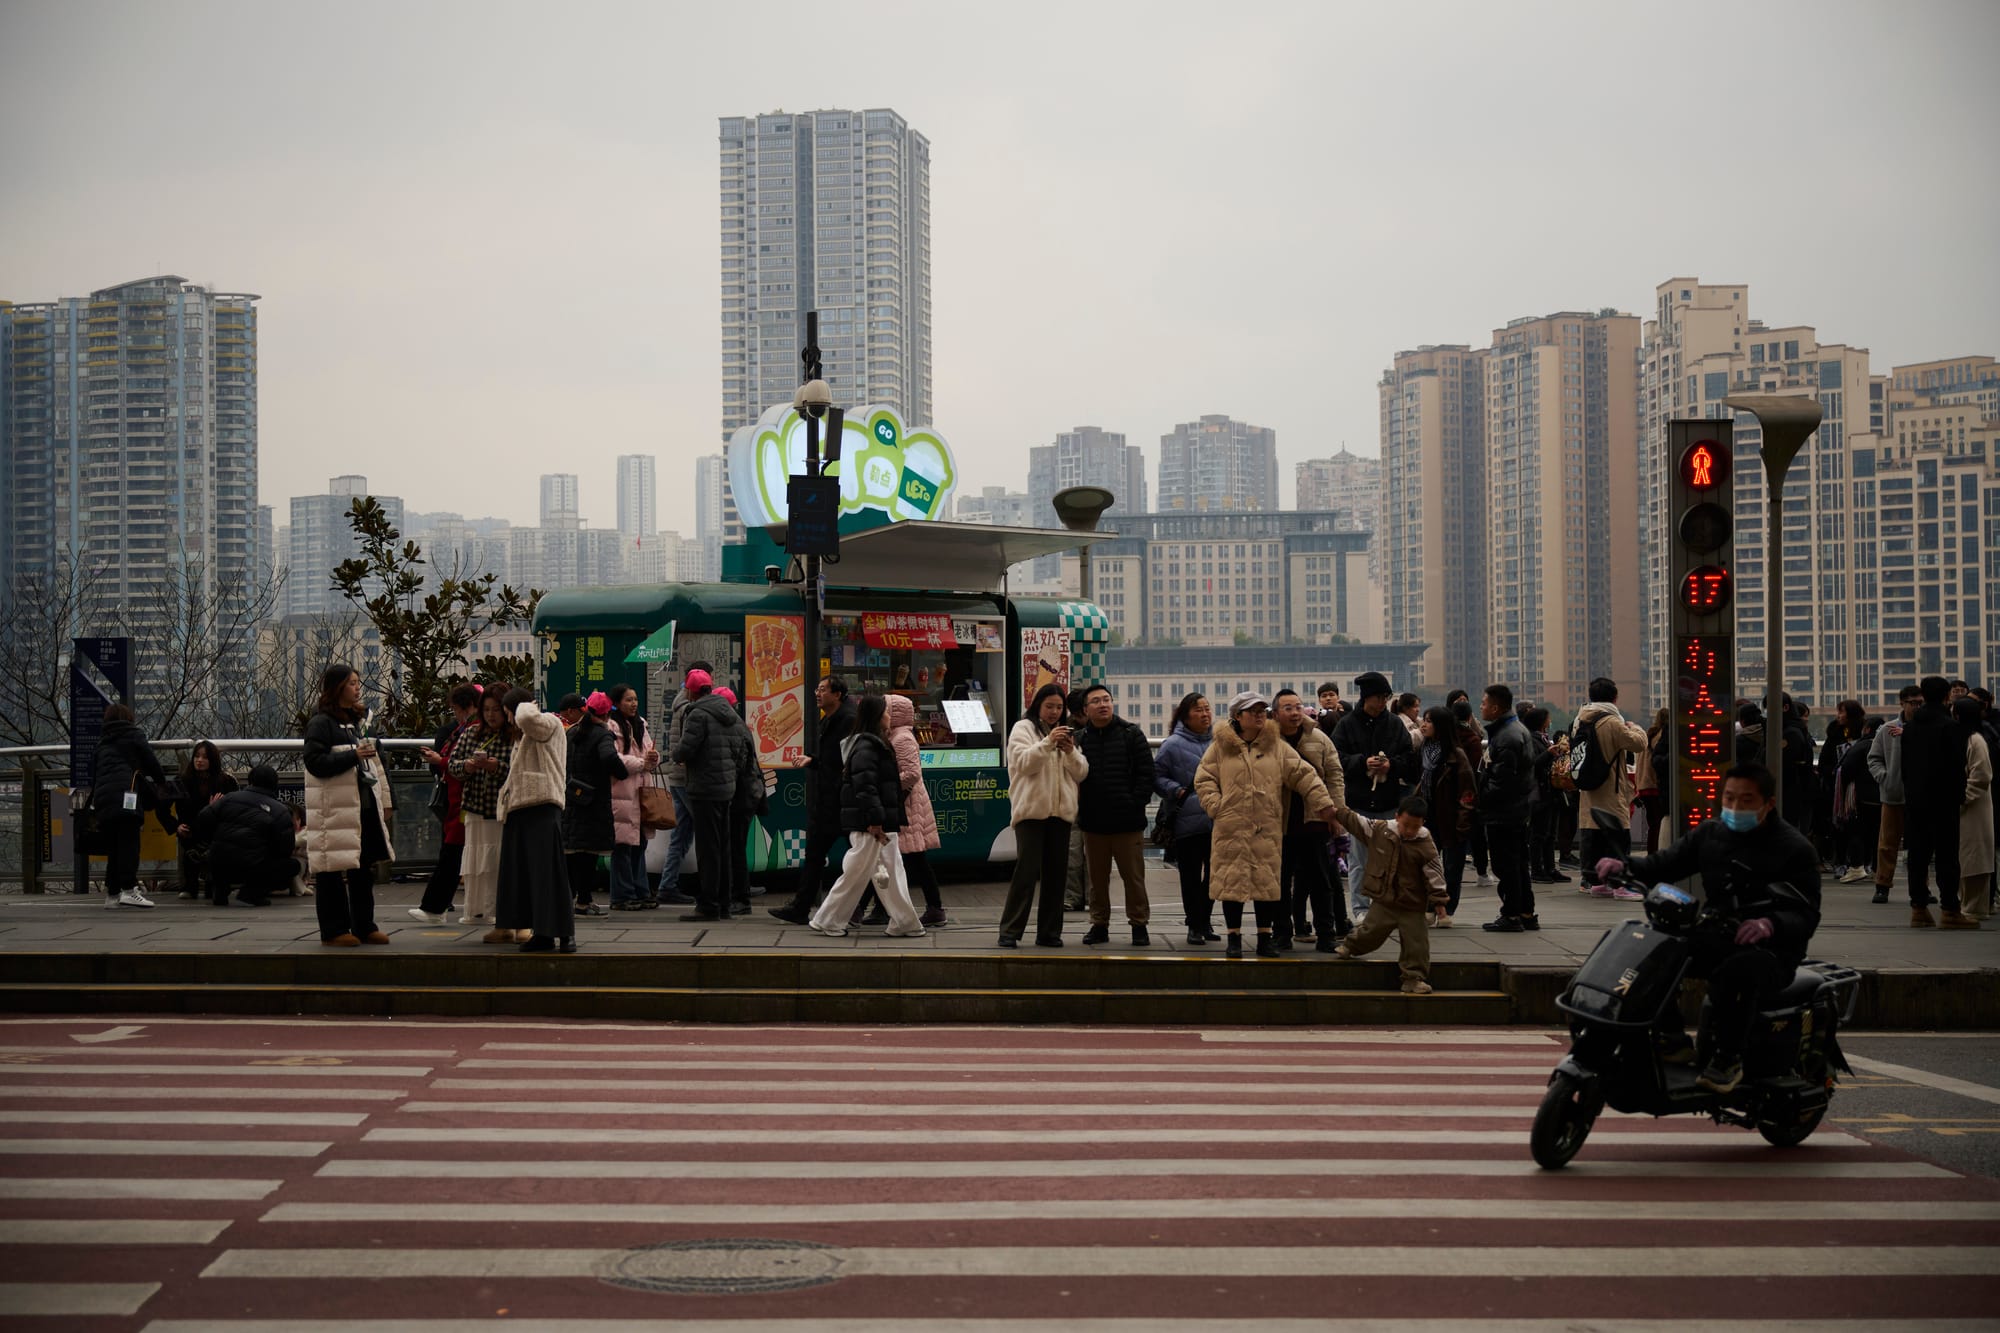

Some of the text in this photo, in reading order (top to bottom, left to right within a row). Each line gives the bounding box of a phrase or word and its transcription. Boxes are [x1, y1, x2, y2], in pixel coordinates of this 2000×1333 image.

[878, 424, 894, 440] GO
[864, 613, 950, 631] 全场奶茶限时特惠
[880, 631, 943, 649] 10元一杯
[1023, 628, 1070, 653] 热奶宝
[955, 778, 998, 790] DRINKS
